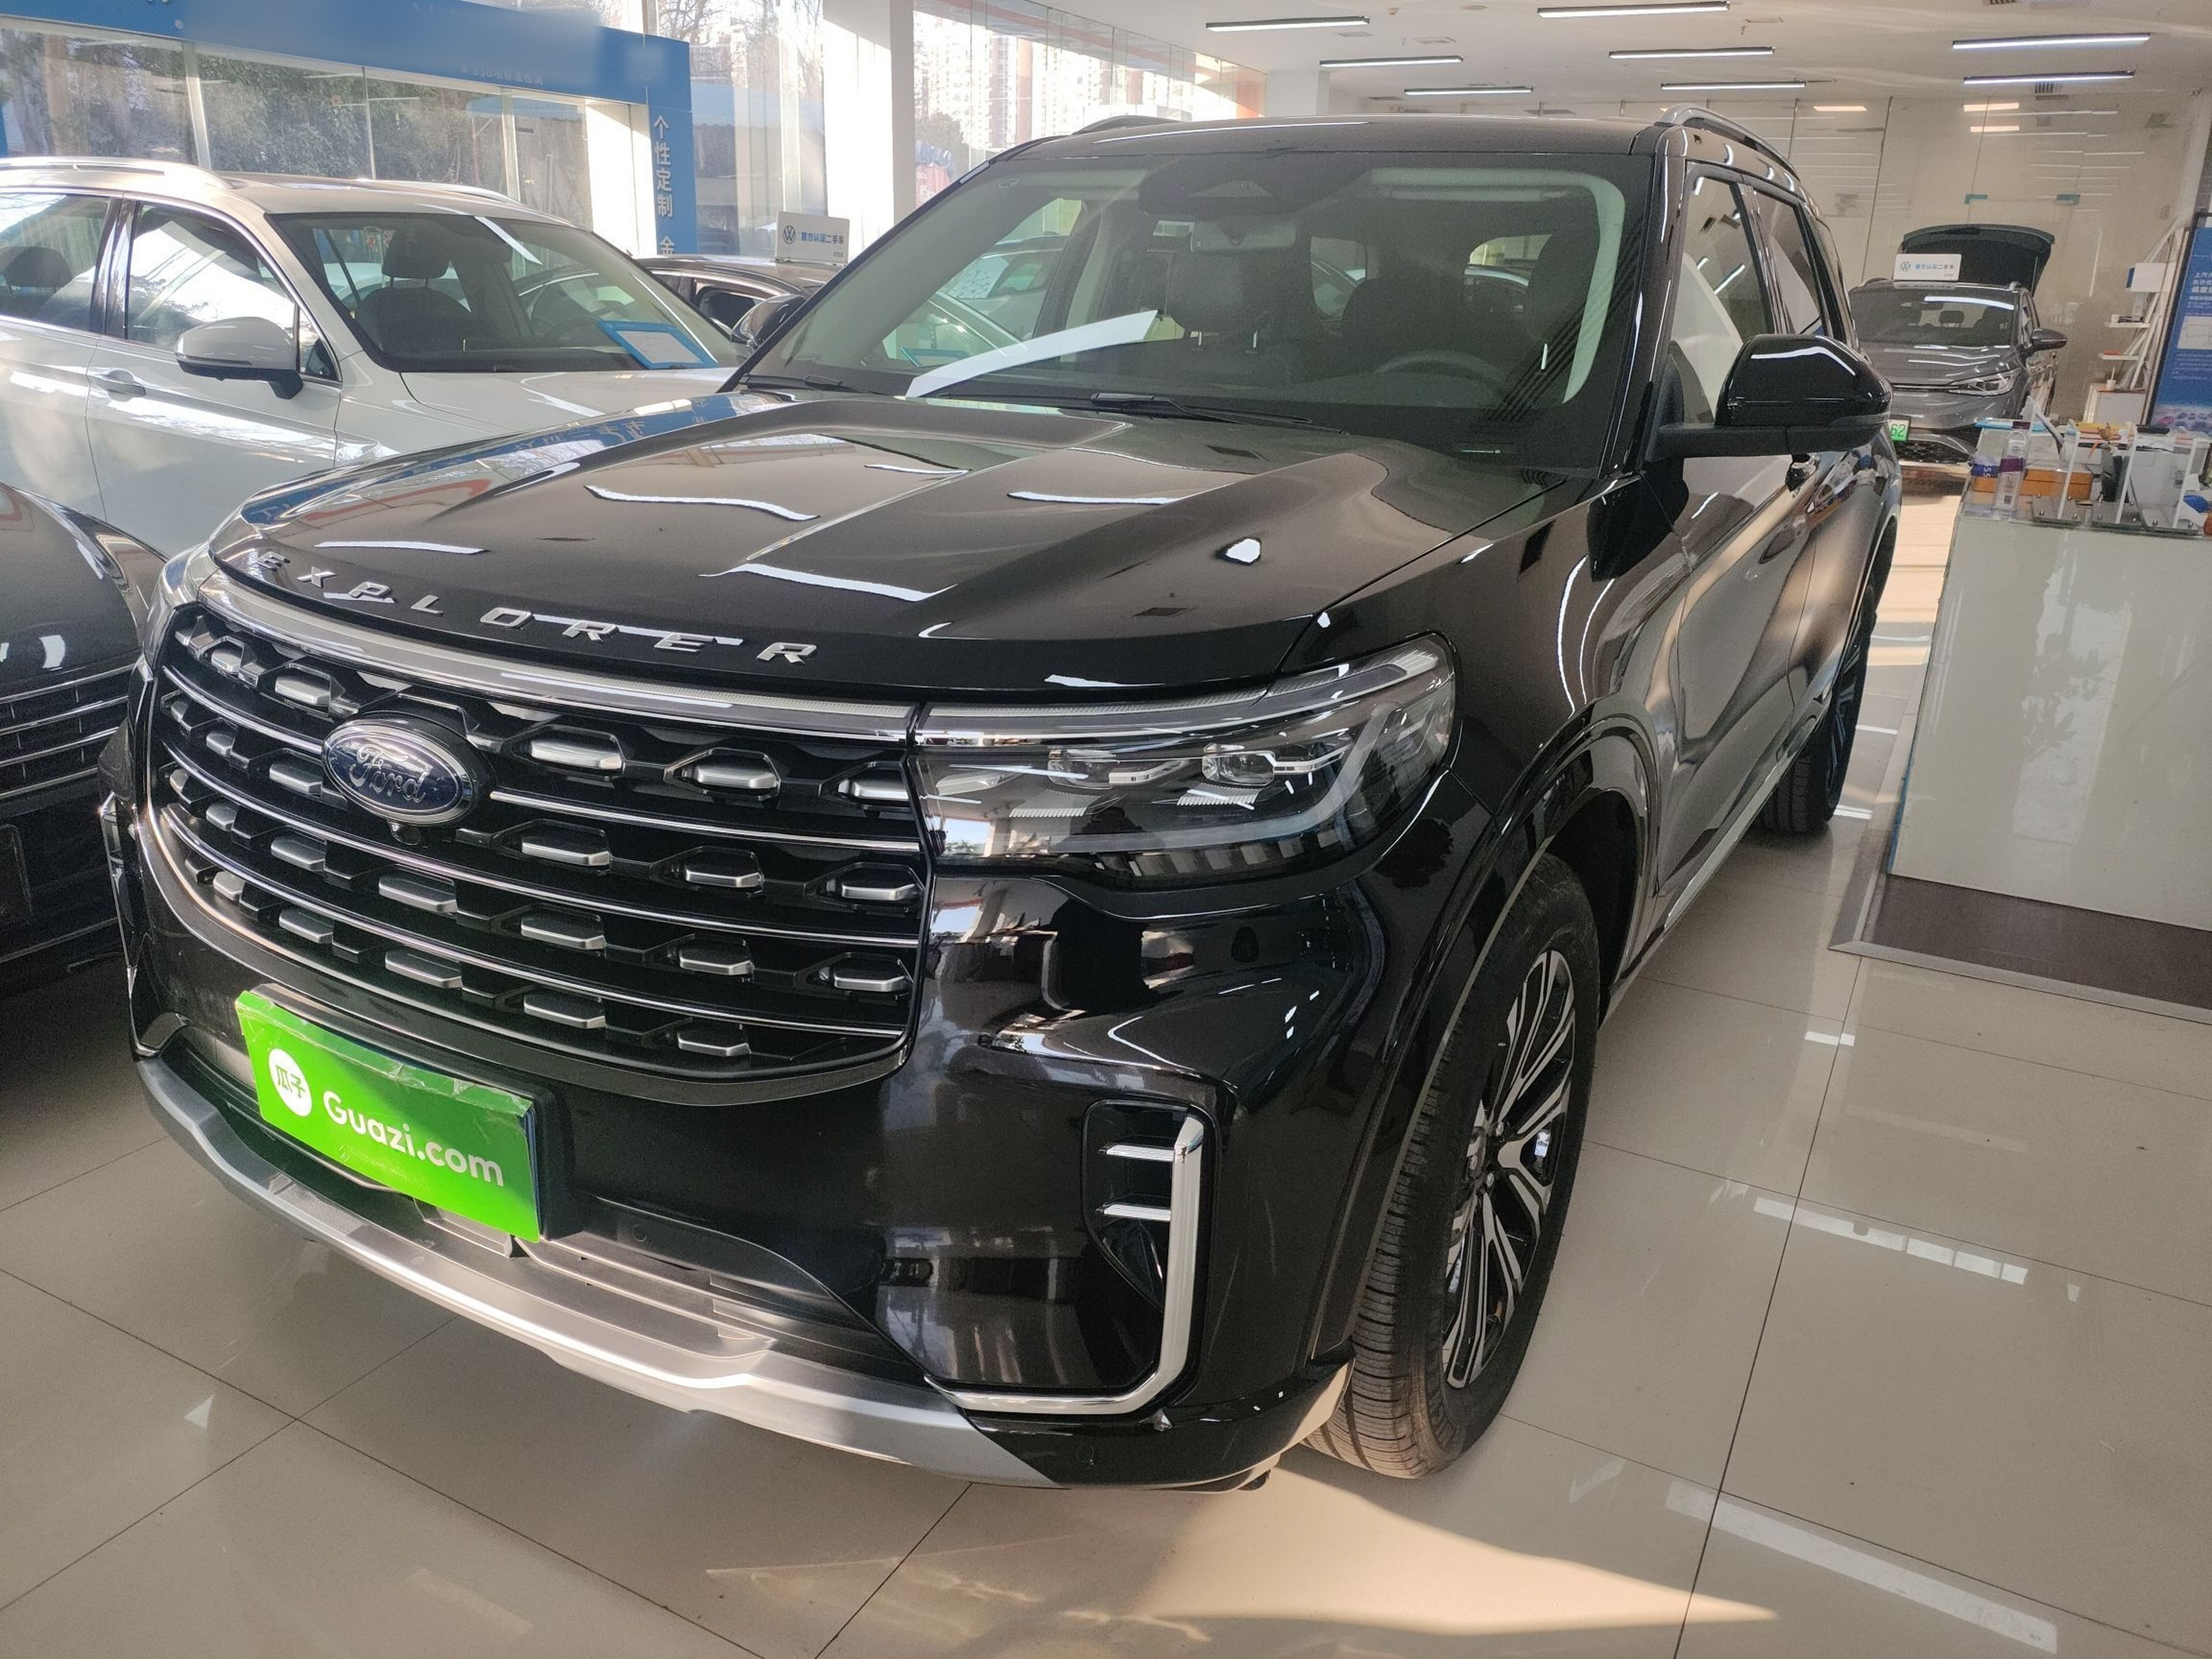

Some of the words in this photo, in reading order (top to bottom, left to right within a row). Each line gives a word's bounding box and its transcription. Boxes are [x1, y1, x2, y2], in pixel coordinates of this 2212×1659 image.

[653, 115, 673, 217] 个性定制
[255, 551, 817, 665] EXPLORER
[349, 745, 434, 804] Ford
[275, 1063, 306, 1099] 瓜子
[323, 1090, 504, 1187] Guazi.com
